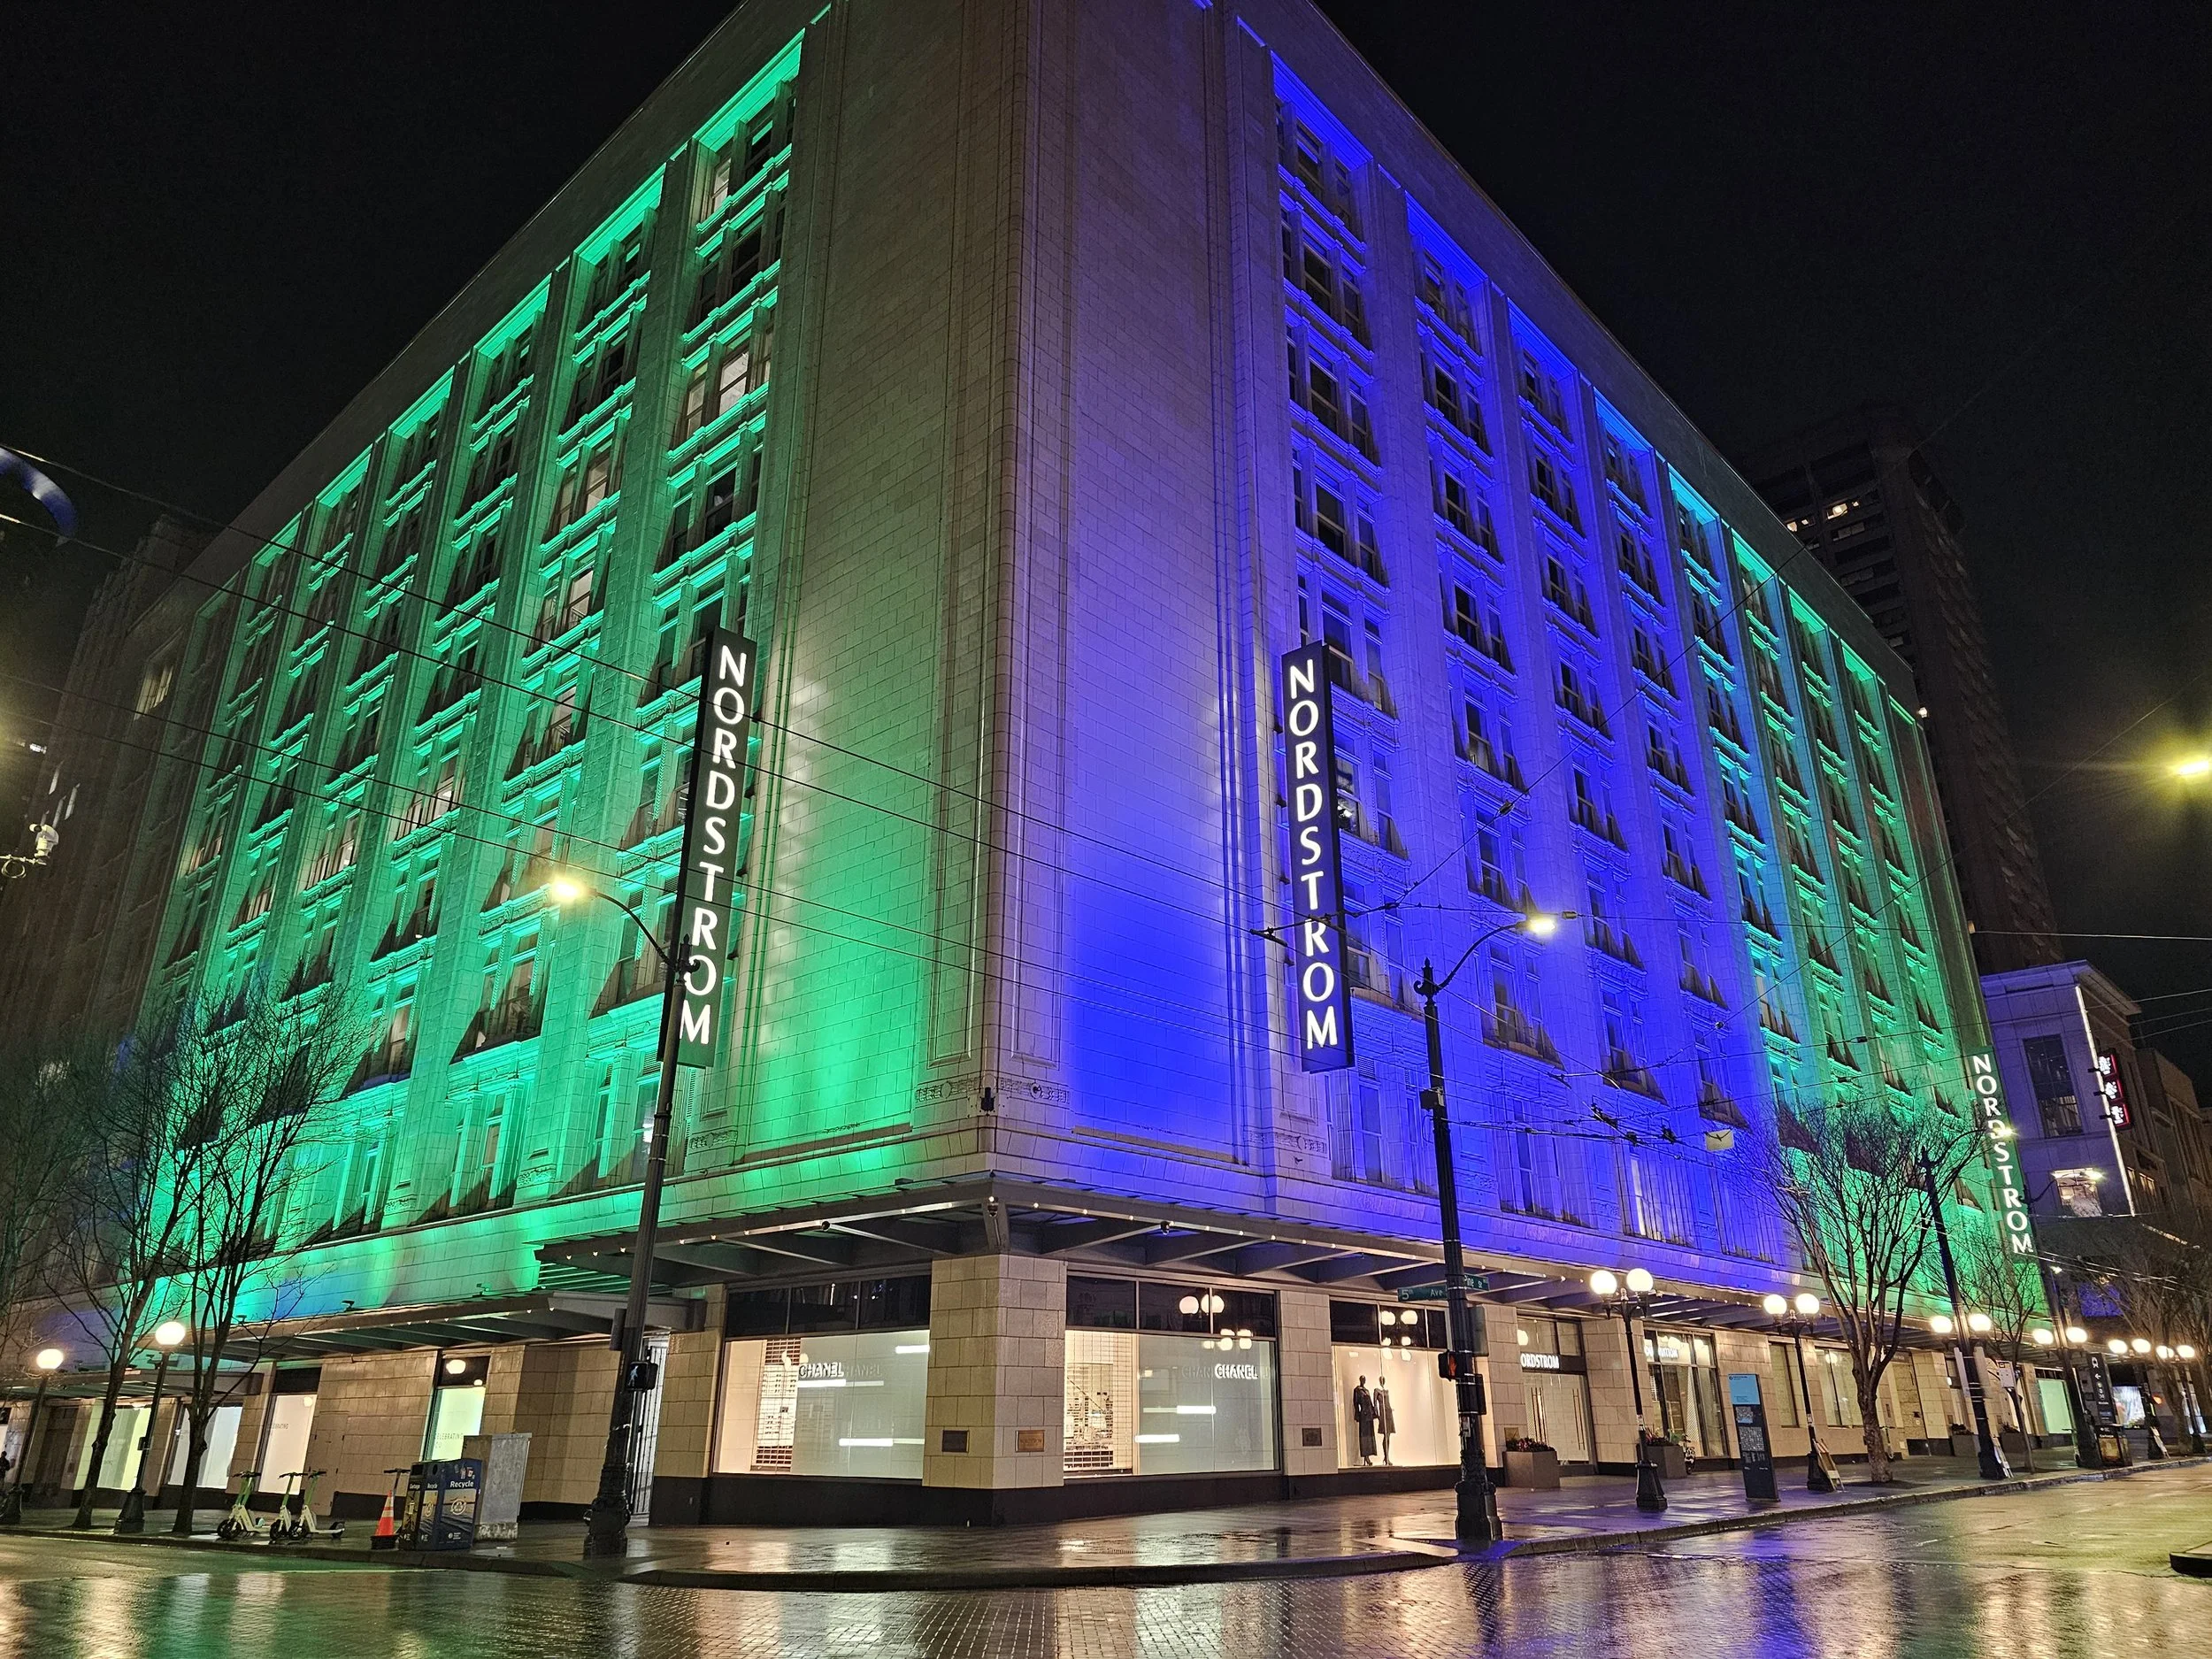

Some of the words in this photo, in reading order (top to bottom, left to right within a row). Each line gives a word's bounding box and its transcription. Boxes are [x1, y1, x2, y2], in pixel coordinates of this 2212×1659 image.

[679, 645, 747, 1045] NORDSTROM
[1288, 658, 1338, 1050] NORDSTROM
[1973, 1054, 2034, 1254] NORDSTROM
[1402, 1289, 1414, 1300] 5th
[1430, 1288, 1443, 1297] Ave
[1520, 1353, 1559, 1369] ORDSTROM
[799, 1362, 844, 1378] CHANEL
[1214, 1363, 1258, 1379] CHANEL
[449, 1479, 474, 1489] Recycle
